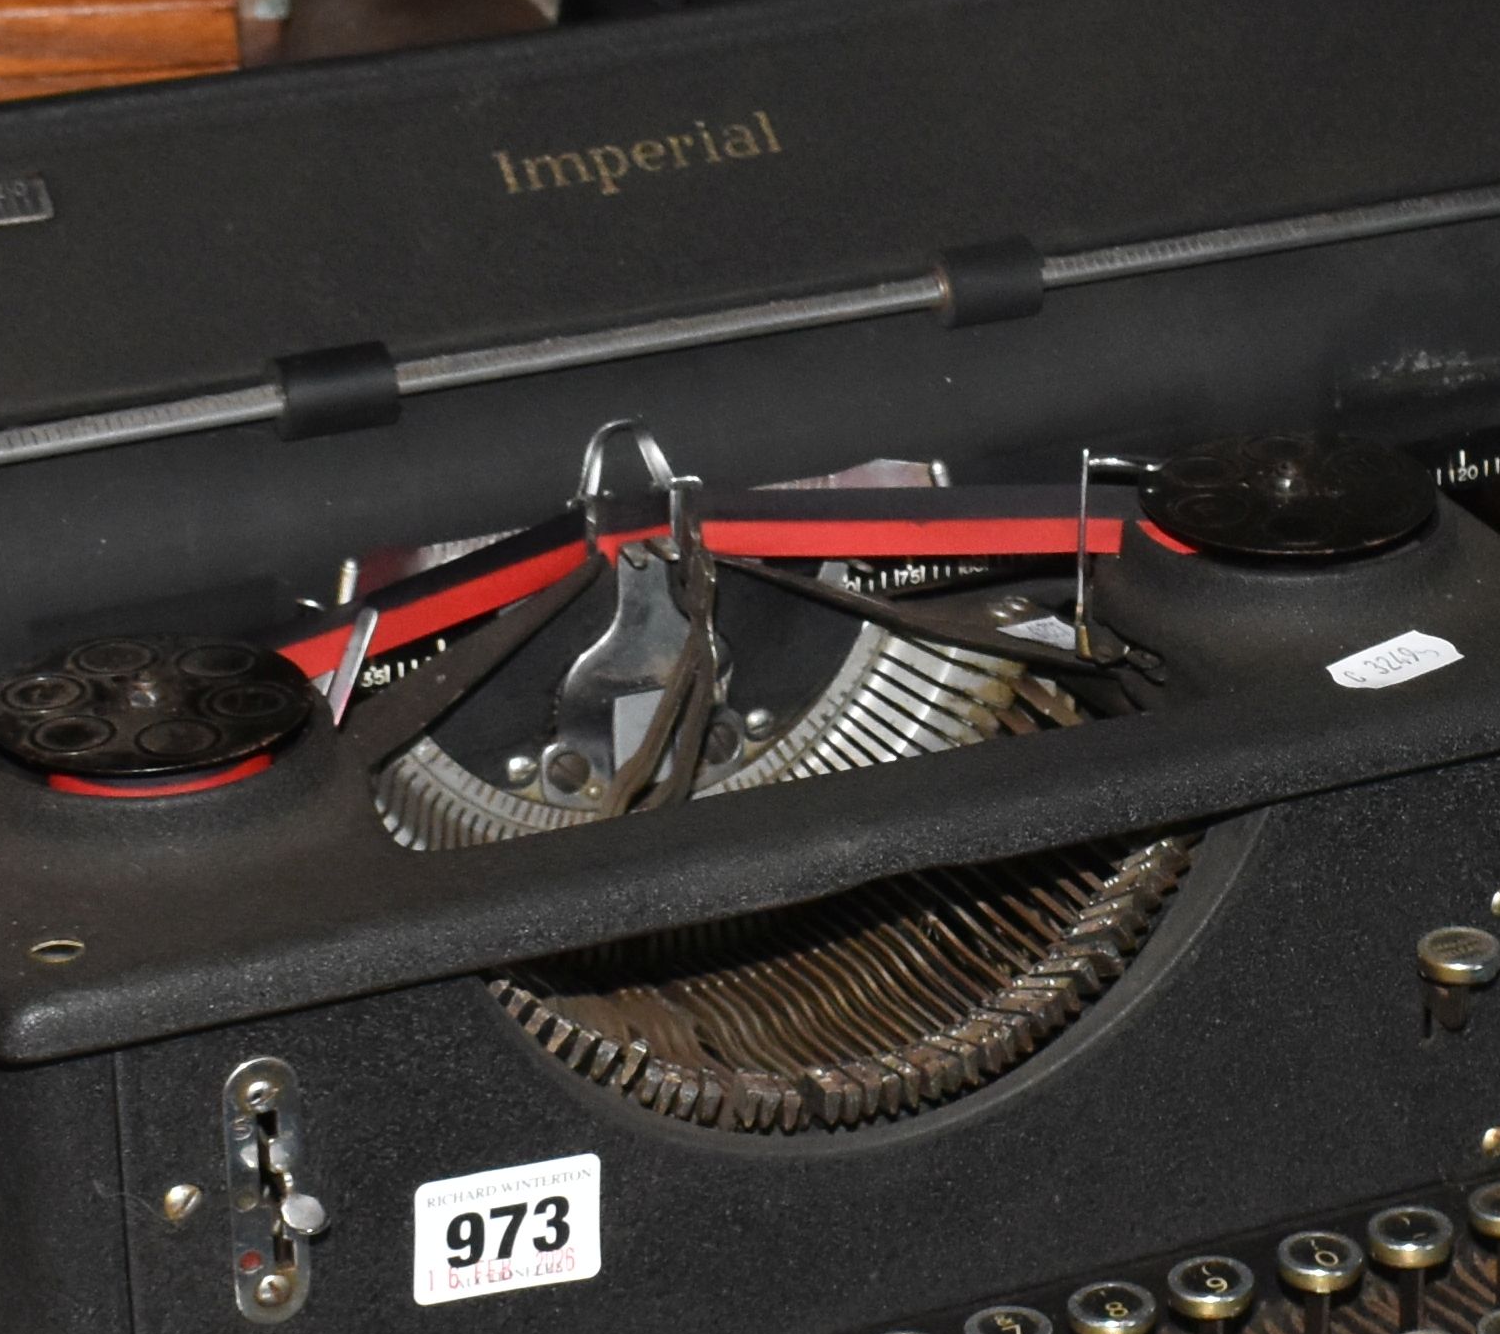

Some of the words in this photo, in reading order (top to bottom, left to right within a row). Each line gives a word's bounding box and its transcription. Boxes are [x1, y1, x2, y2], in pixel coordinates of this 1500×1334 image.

[492, 110, 782, 196] Imperial
[426, 1185, 497, 1209] RICHARD
[500, 1168, 593, 1194] WINTERTON
[445, 1195, 571, 1269] 973
[1104, 1301, 1129, 1318] 8
[1205, 1276, 1229, 1294] 9
